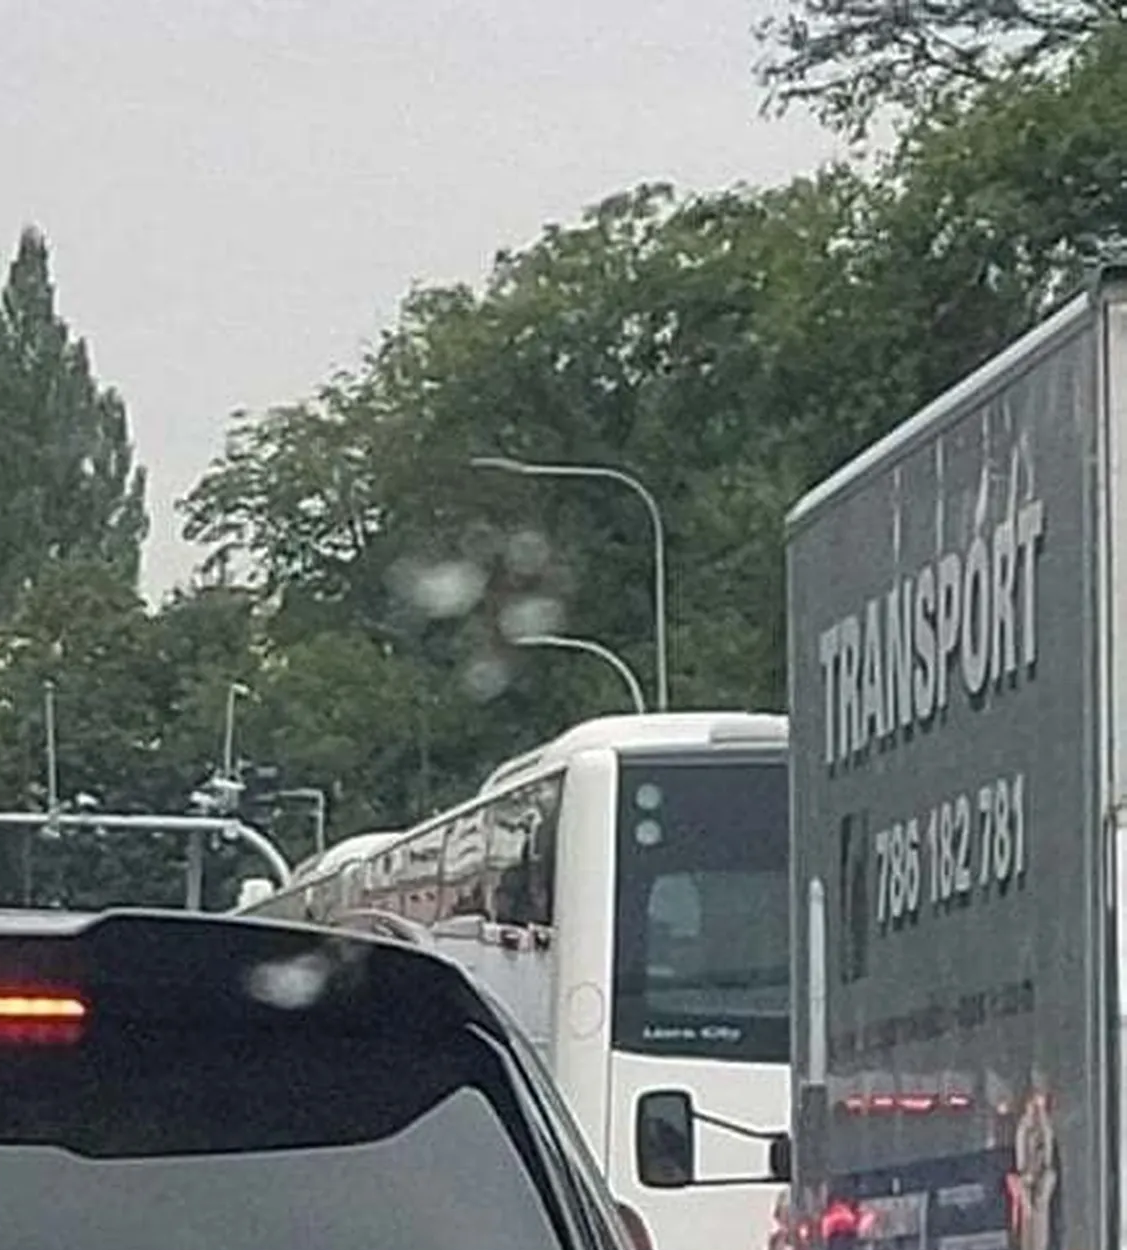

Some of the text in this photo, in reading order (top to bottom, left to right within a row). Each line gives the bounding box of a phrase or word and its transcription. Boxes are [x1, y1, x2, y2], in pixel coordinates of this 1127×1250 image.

[820, 500, 1044, 764] TRANSPORT
[876, 773, 1025, 924] 786 182 781
